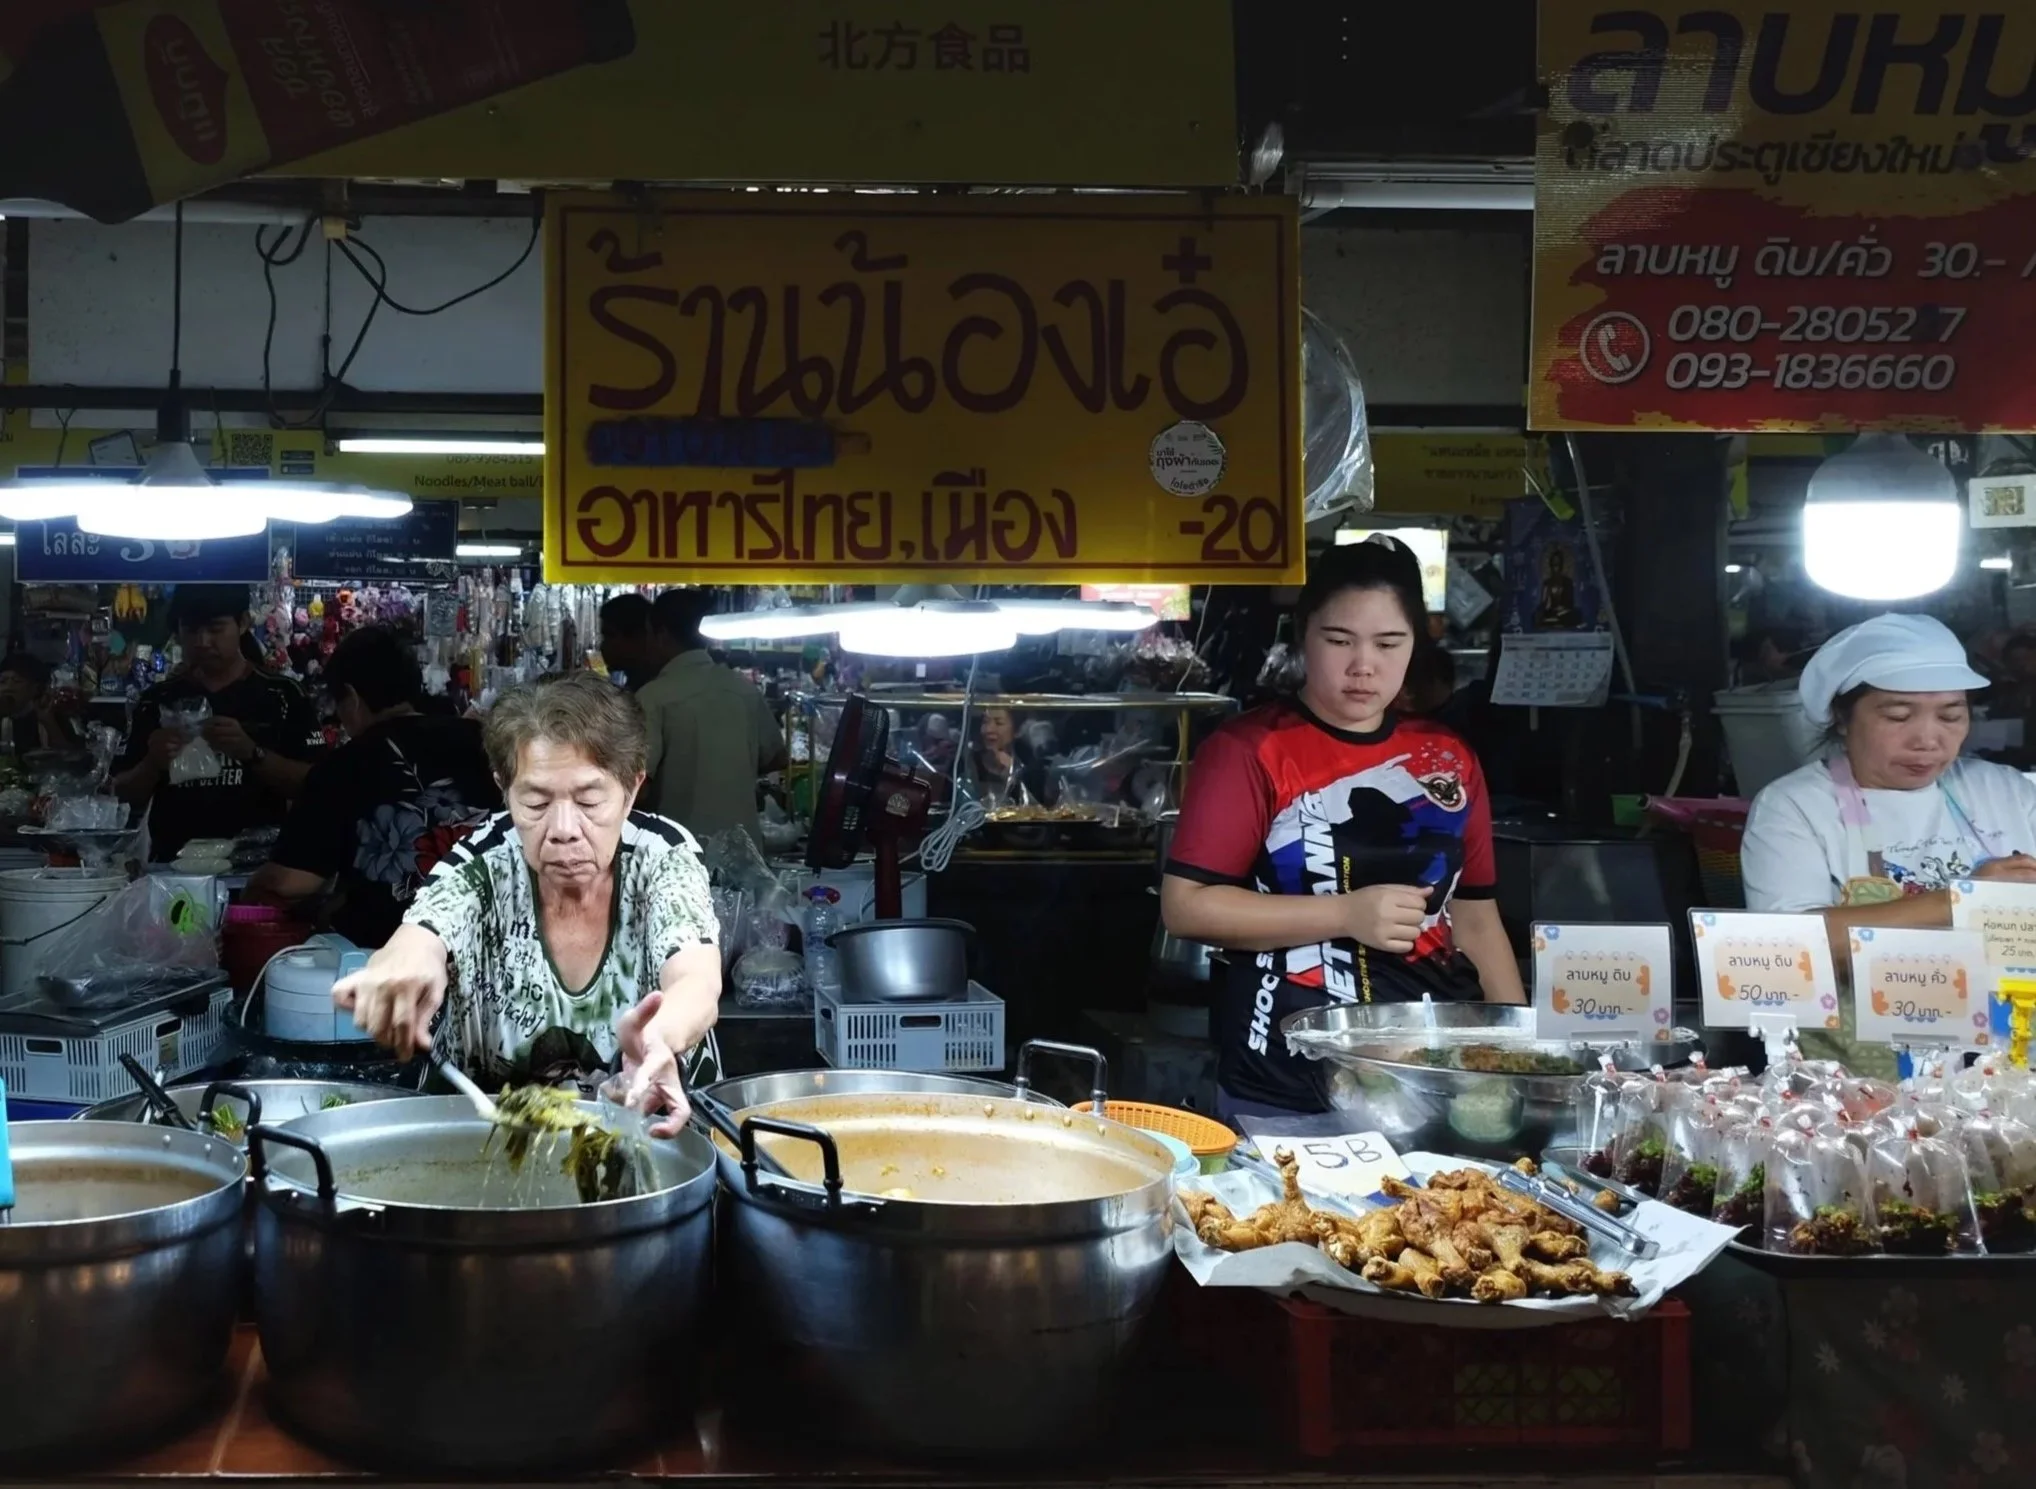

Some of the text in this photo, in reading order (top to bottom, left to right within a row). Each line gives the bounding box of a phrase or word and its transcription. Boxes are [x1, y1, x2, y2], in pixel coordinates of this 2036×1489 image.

[818, 20, 1031, 74] 北方食品
[1595, 243, 1740, 290] ลาบหมู
[1753, 224, 1893, 278] ดิบ/คั่ว
[1916, 241, 2007, 279] 30.-
[587, 229, 1250, 420] ร้านน้องเอ๋
[1667, 305, 1967, 343] 080-280527
[1665, 352, 1955, 390] 093-1836660
[414, 475, 507, 488] Noodles/Meat
[1179, 495, 1283, 562] -20
[1728, 954, 1793, 971] ลาบหมู ดิบ
[1566, 968, 1631, 985] ลาบหมู ดิบ
[1884, 968, 1948, 988] ลาบหมู คั่ว
[1739, 984, 1763, 1001] 50
[1571, 998, 1597, 1015] 30
[1892, 1000, 1916, 1017] 30
